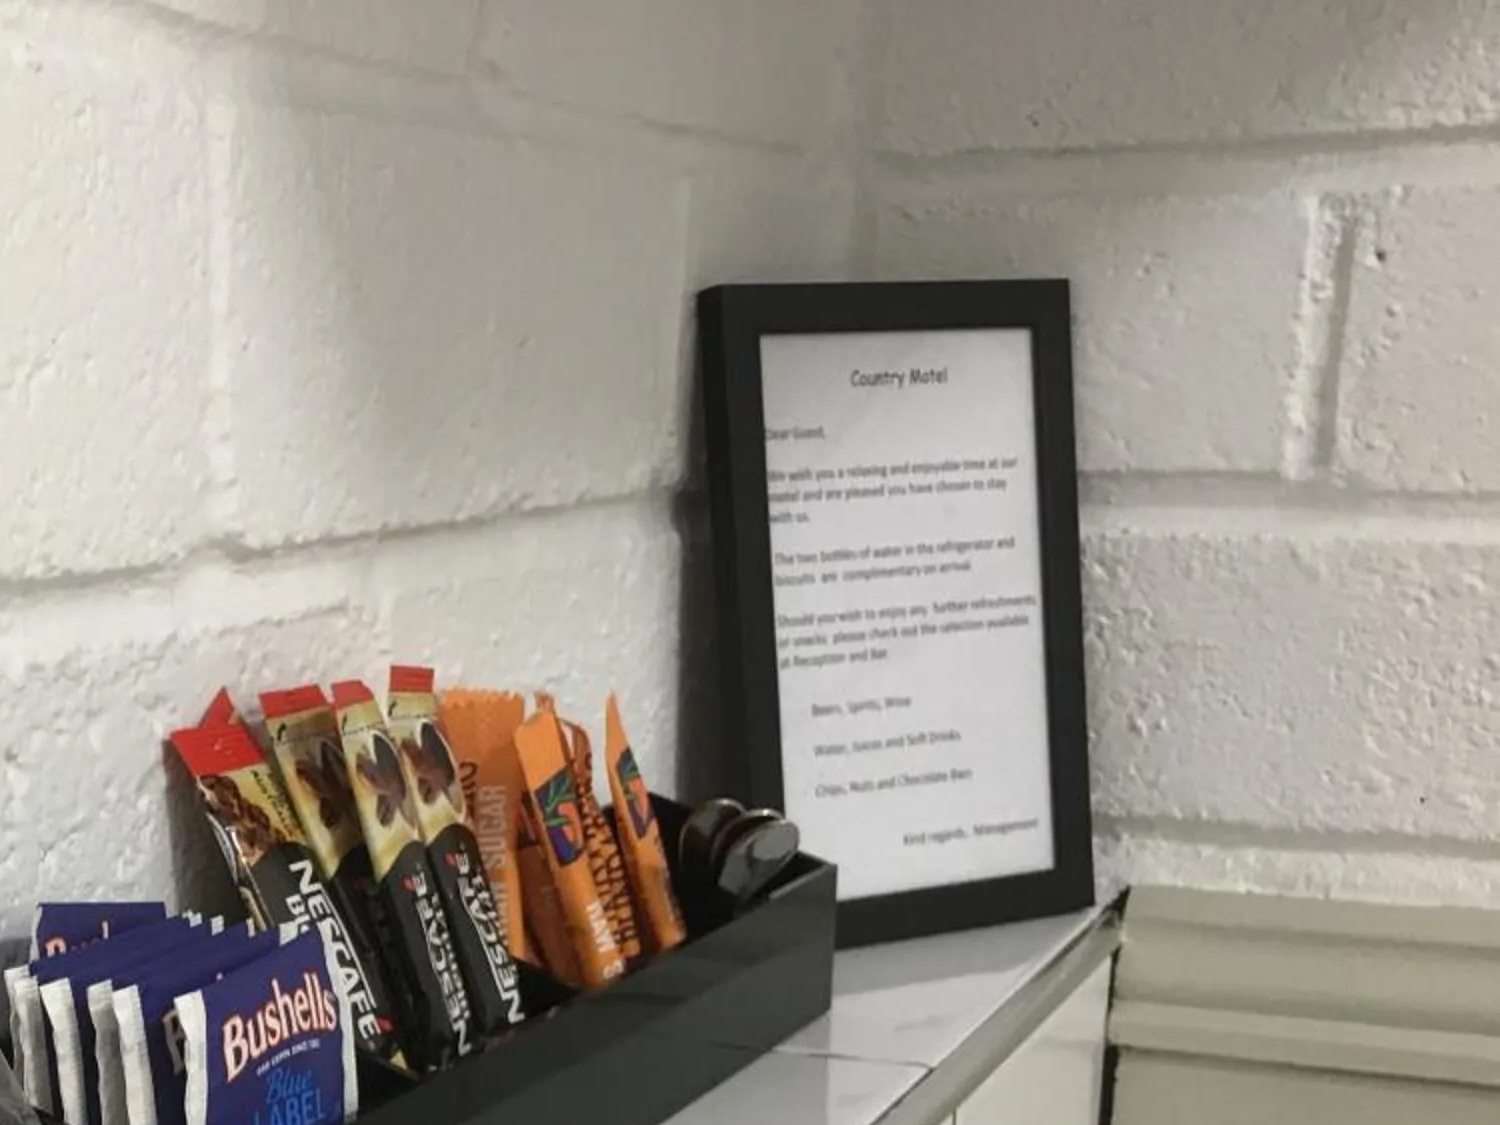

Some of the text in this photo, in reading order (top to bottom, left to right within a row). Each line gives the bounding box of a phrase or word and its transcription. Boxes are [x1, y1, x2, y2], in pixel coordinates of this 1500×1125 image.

[850, 367, 948, 390] Country Motel
[477, 786, 507, 869] SUGAR
[222, 972, 338, 1084] Bushells
[264, 1066, 313, 1104] Blue
